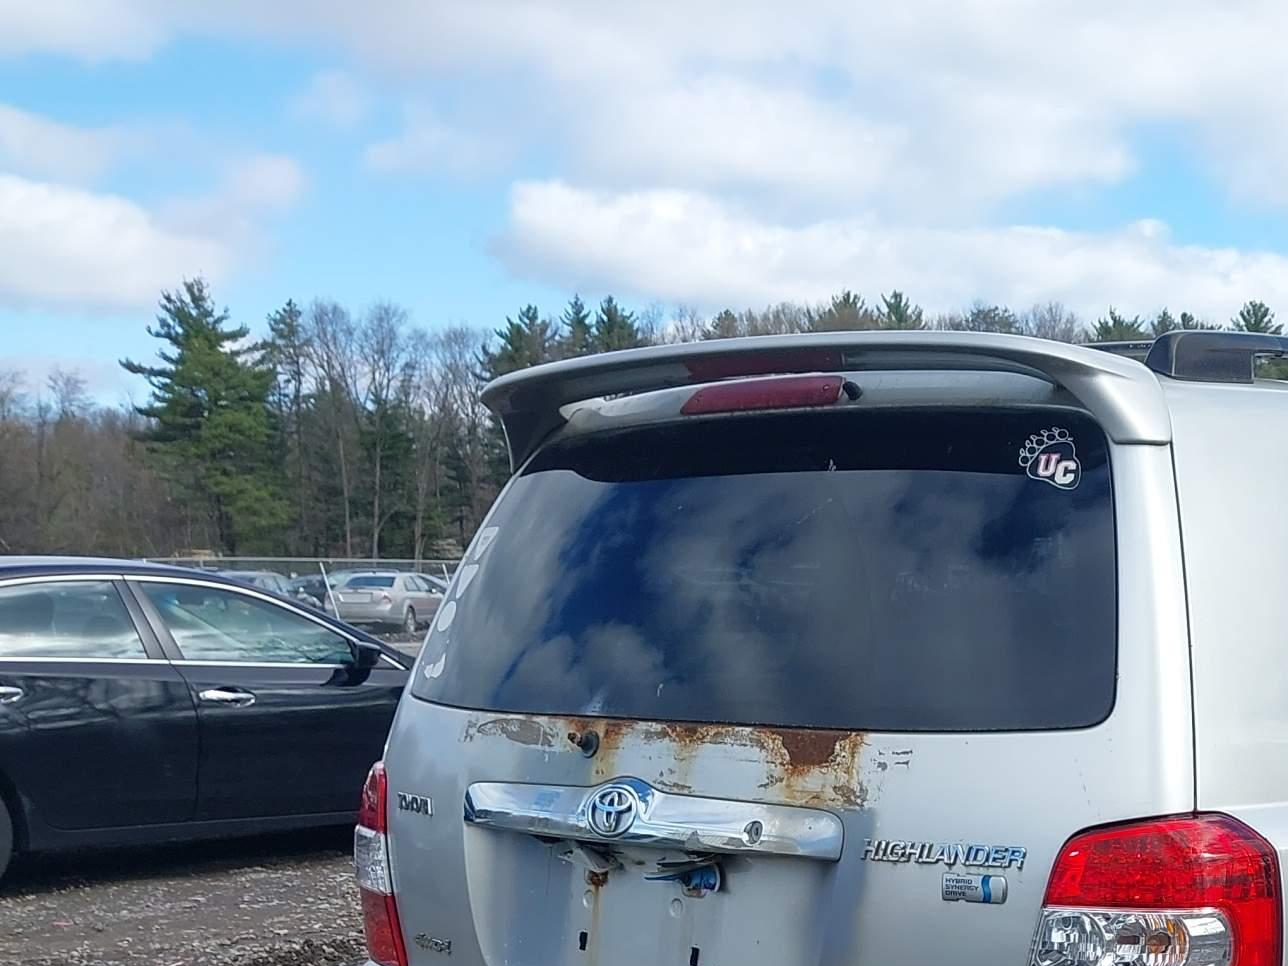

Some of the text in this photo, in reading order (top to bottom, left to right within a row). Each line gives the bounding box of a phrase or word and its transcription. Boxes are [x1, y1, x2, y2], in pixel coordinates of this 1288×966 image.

[1036, 453, 1078, 485] UC
[861, 838, 1027, 870] HIGHLANDER
[945, 877, 973, 885] HYBRID
[945, 884, 979, 892] SYNERGY
